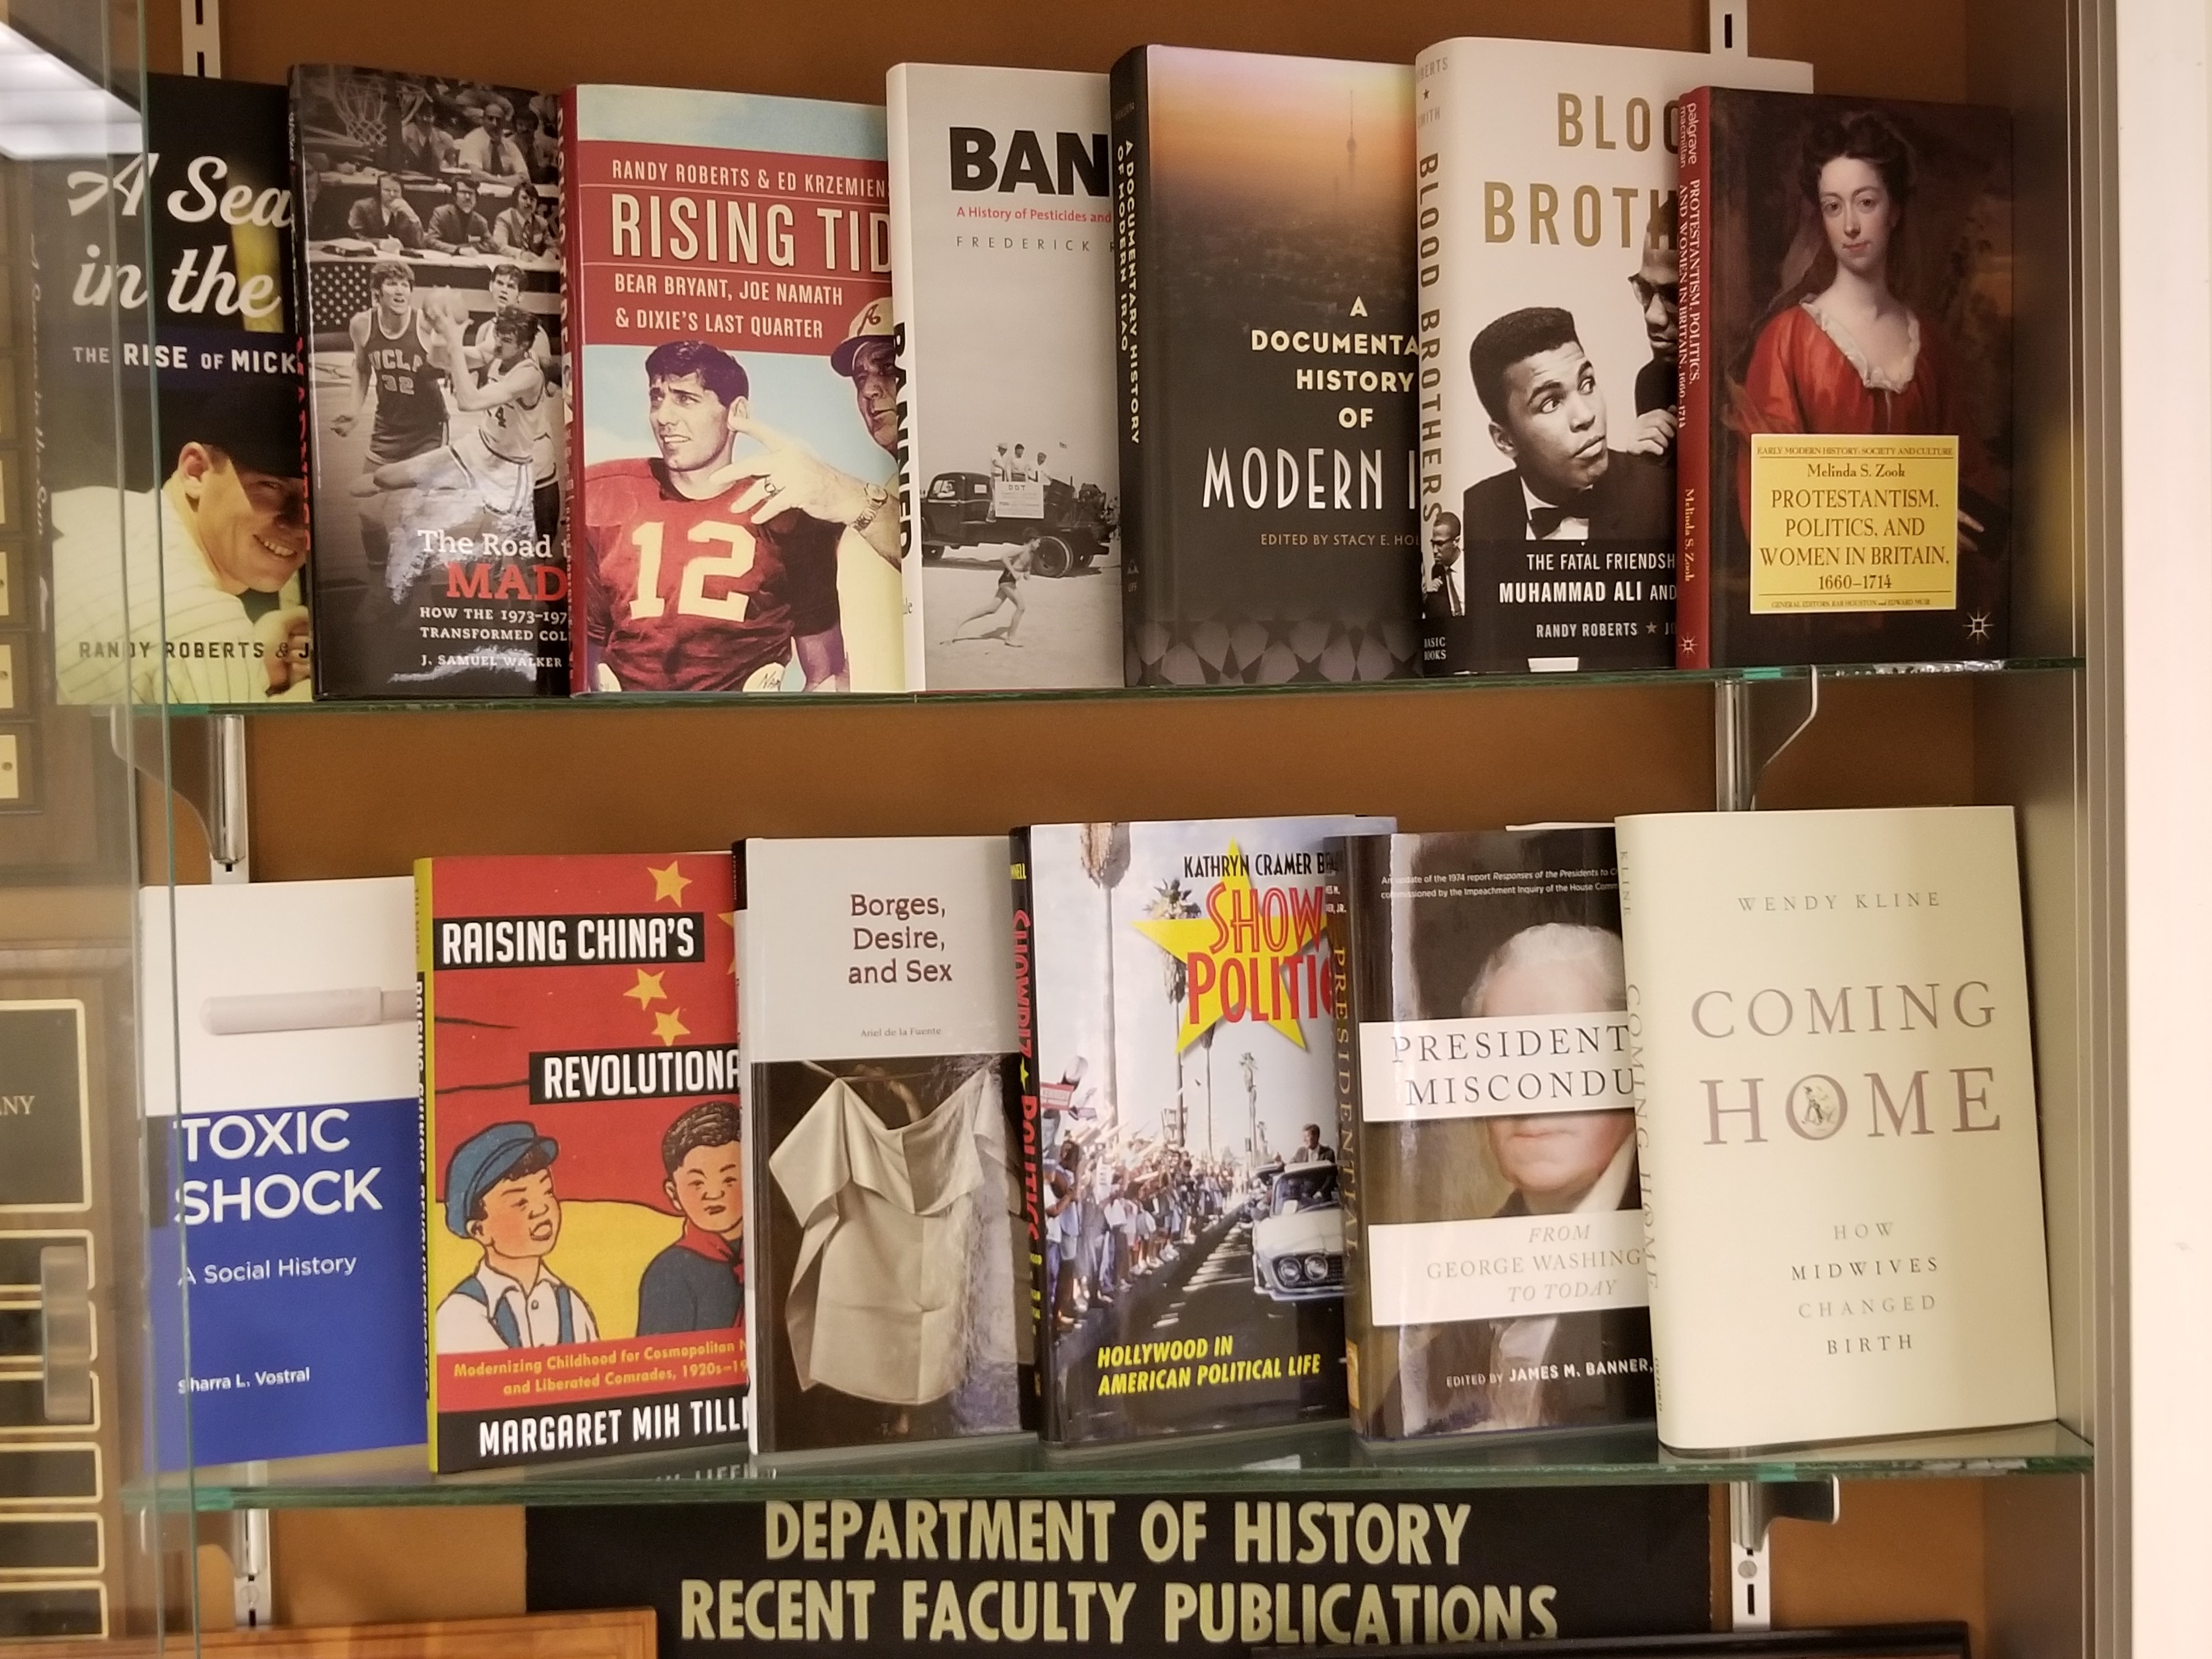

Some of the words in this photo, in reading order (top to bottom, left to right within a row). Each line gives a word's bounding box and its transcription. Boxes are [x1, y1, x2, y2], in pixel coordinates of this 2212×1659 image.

[1686, 103, 1699, 165] palgrave
[950, 126, 1110, 198] BAN
[1117, 145, 1125, 176] OF
[612, 160, 668, 182] RANDY
[676, 163, 749, 188] ROBERTS
[757, 170, 770, 189] &
[778, 172, 797, 191] ED
[805, 174, 886, 199] KRZEMIEN
[957, 206, 966, 217] A
[969, 206, 1012, 222] History
[1015, 208, 1027, 219] of
[1030, 210, 1087, 222] Pesticides
[1090, 212, 1111, 223] and
[1679, 185, 1689, 218] AND
[612, 193, 795, 268] RISING
[1118, 182, 1127, 283] MODERN
[1419, 153, 1440, 288] BLOOD
[956, 236, 1090, 252] FREDERICK
[1126, 161, 1138, 337] DOCUMENTARY
[1679, 222, 1688, 284] WOMEN
[167, 245, 281, 318] the
[614, 273, 657, 295] BEAR
[664, 275, 733, 302] BRYANT,
[739, 281, 769, 302] JOE
[776, 283, 843, 306] NAMATH
[1349, 295, 1368, 318] A
[706, 313, 744, 334] LAST
[751, 316, 823, 339] QUARTER
[1120, 294, 1128, 352] IRAQ
[1251, 329, 1419, 356] DOCUMENTA
[73, 346, 109, 364] THE
[123, 343, 188, 369] RISE
[201, 354, 225, 369] OF
[232, 350, 296, 375] MICK
[1129, 344, 1140, 444] HISTORY
[1296, 369, 1415, 393] HISTORY
[1338, 407, 1374, 428] OF
[1420, 308, 1444, 523] BROTHERS
[1203, 447, 1383, 510] MODERN
[1807, 463, 1857, 478] Melinda
[1860, 464, 1872, 478] S.
[1875, 463, 1905, 478] Zook
[1684, 488, 1695, 536] Melinda
[1883, 517, 1925, 537] AND
[418, 529, 473, 555] The
[483, 533, 552, 558] Road
[1261, 533, 1308, 546] EDITED
[1313, 534, 1329, 546] BY
[1333, 534, 1376, 546] STACY
[1380, 535, 1390, 546] E.
[629, 520, 757, 623] 12
[1526, 554, 1555, 571] THE
[1560, 554, 1601, 571] FATAL
[1606, 554, 1675, 571] FRIENDSH
[1759, 546, 1839, 567] WOMEN
[1845, 546, 1865, 566] IN
[446, 562, 567, 601] MAD
[1499, 582, 1606, 603] MUHAMMAD
[1613, 581, 1642, 601] ALI
[1650, 585, 1677, 601] AND
[420, 607, 458, 619] HOW
[464, 609, 494, 621] THE
[420, 627, 534, 641] TRANSFORMED
[539, 630, 567, 642] COL
[1536, 623, 1577, 639] RANDY
[1582, 622, 1638, 637] ROBERTS
[80, 641, 150, 658] RANDY
[165, 642, 265, 658] ROBERTS
[421, 654, 432, 667] J.
[438, 654, 497, 666] SAMUEL
[504, 656, 562, 668] WALKER
[1183, 854, 1250, 878] KATHRYN
[1255, 853, 1312, 876] CRAMER
[1424, 874, 1432, 883] of
[1434, 874, 1447, 883] the
[1448, 873, 1465, 883] 1974
[1467, 873, 1491, 884] report
[1493, 871, 1533, 882] Responses
[1545, 870, 1558, 879] the
[1559, 868, 1599, 878] Presidents
[1438, 888, 1448, 898] by
[1450, 887, 1462, 896] the
[1464, 885, 1515, 896] Impeachment
[1517, 885, 1544, 896] Inquiry
[1555, 884, 1568, 893] the
[1570, 883, 1593, 893] House
[1619, 850, 1632, 917] KLINE
[850, 894, 946, 921] Borges,
[1738, 894, 1838, 912] WENDY
[1855, 891, 1941, 909] KLINE
[1206, 881, 1324, 955] SHOW
[442, 919, 567, 965] RAISING
[853, 926, 945, 952] Desire,
[848, 958, 898, 985] and
[906, 960, 953, 983] Sex
[1691, 980, 1996, 1039] COMING
[861, 1028, 882, 1037] Ariel
[884, 1028, 896, 1036] de
[910, 1027, 941, 1036] Fuente
[1391, 1024, 1630, 1064] PRESIDENT
[1405, 1068, 1634, 1107] MISCONDU
[1700, 1066, 2001, 1146] HOME
[173, 1108, 351, 1162] TOXIC
[174, 1166, 383, 1226] SHOCK
[1528, 1224, 1590, 1244] FROM
[1833, 1221, 1894, 1240] HOW
[205, 1260, 270, 1285] Social
[278, 1256, 357, 1278] History
[1427, 1256, 1525, 1280] GEORGE
[1532, 1248, 1641, 1272] WASHING
[1791, 1256, 1938, 1281] MIDWIVES
[1508, 1284, 1536, 1303] TO
[1545, 1279, 1618, 1300] TODAY
[1798, 1295, 1936, 1319] CHANGED
[454, 1358, 543, 1378] Modernizing
[546, 1350, 617, 1370] Childhood
[620, 1347, 640, 1363] for
[644, 1340, 735, 1361] Cosmopolitan
[1098, 1337, 1208, 1369] HOLLYWOOD
[1214, 1335, 1234, 1357] IN
[1827, 1334, 1913, 1355] BIRTH
[178, 1375, 231, 1395] Sharra
[256, 1366, 311, 1386] Vostral
[503, 1380, 531, 1396] and
[535, 1373, 601, 1393] Liberated
[605, 1368, 677, 1387] Comrades,
[1098, 1367, 1192, 1396] AMERICAN
[1197, 1358, 1282, 1387] POLITICAL
[1288, 1353, 1321, 1377] LIFE
[1446, 1373, 1487, 1389] EDITED
[1489, 1372, 1503, 1387] BY
[1509, 1362, 1559, 1383] JAMES
[1563, 1363, 1581, 1379] M.
[1586, 1357, 1654, 1377] BANNER,
[479, 1408, 623, 1458] MARGARET
[632, 1402, 681, 1442] MIH
[765, 1498, 1116, 1563] DEPARTMENT
[1140, 1500, 1207, 1564] OF
[1234, 1501, 1471, 1566] HISTORY
[681, 1578, 876, 1641] RECENT
[902, 1579, 1137, 1644] FACULTY
[1164, 1581, 1558, 1645] PUBLICATIONS
